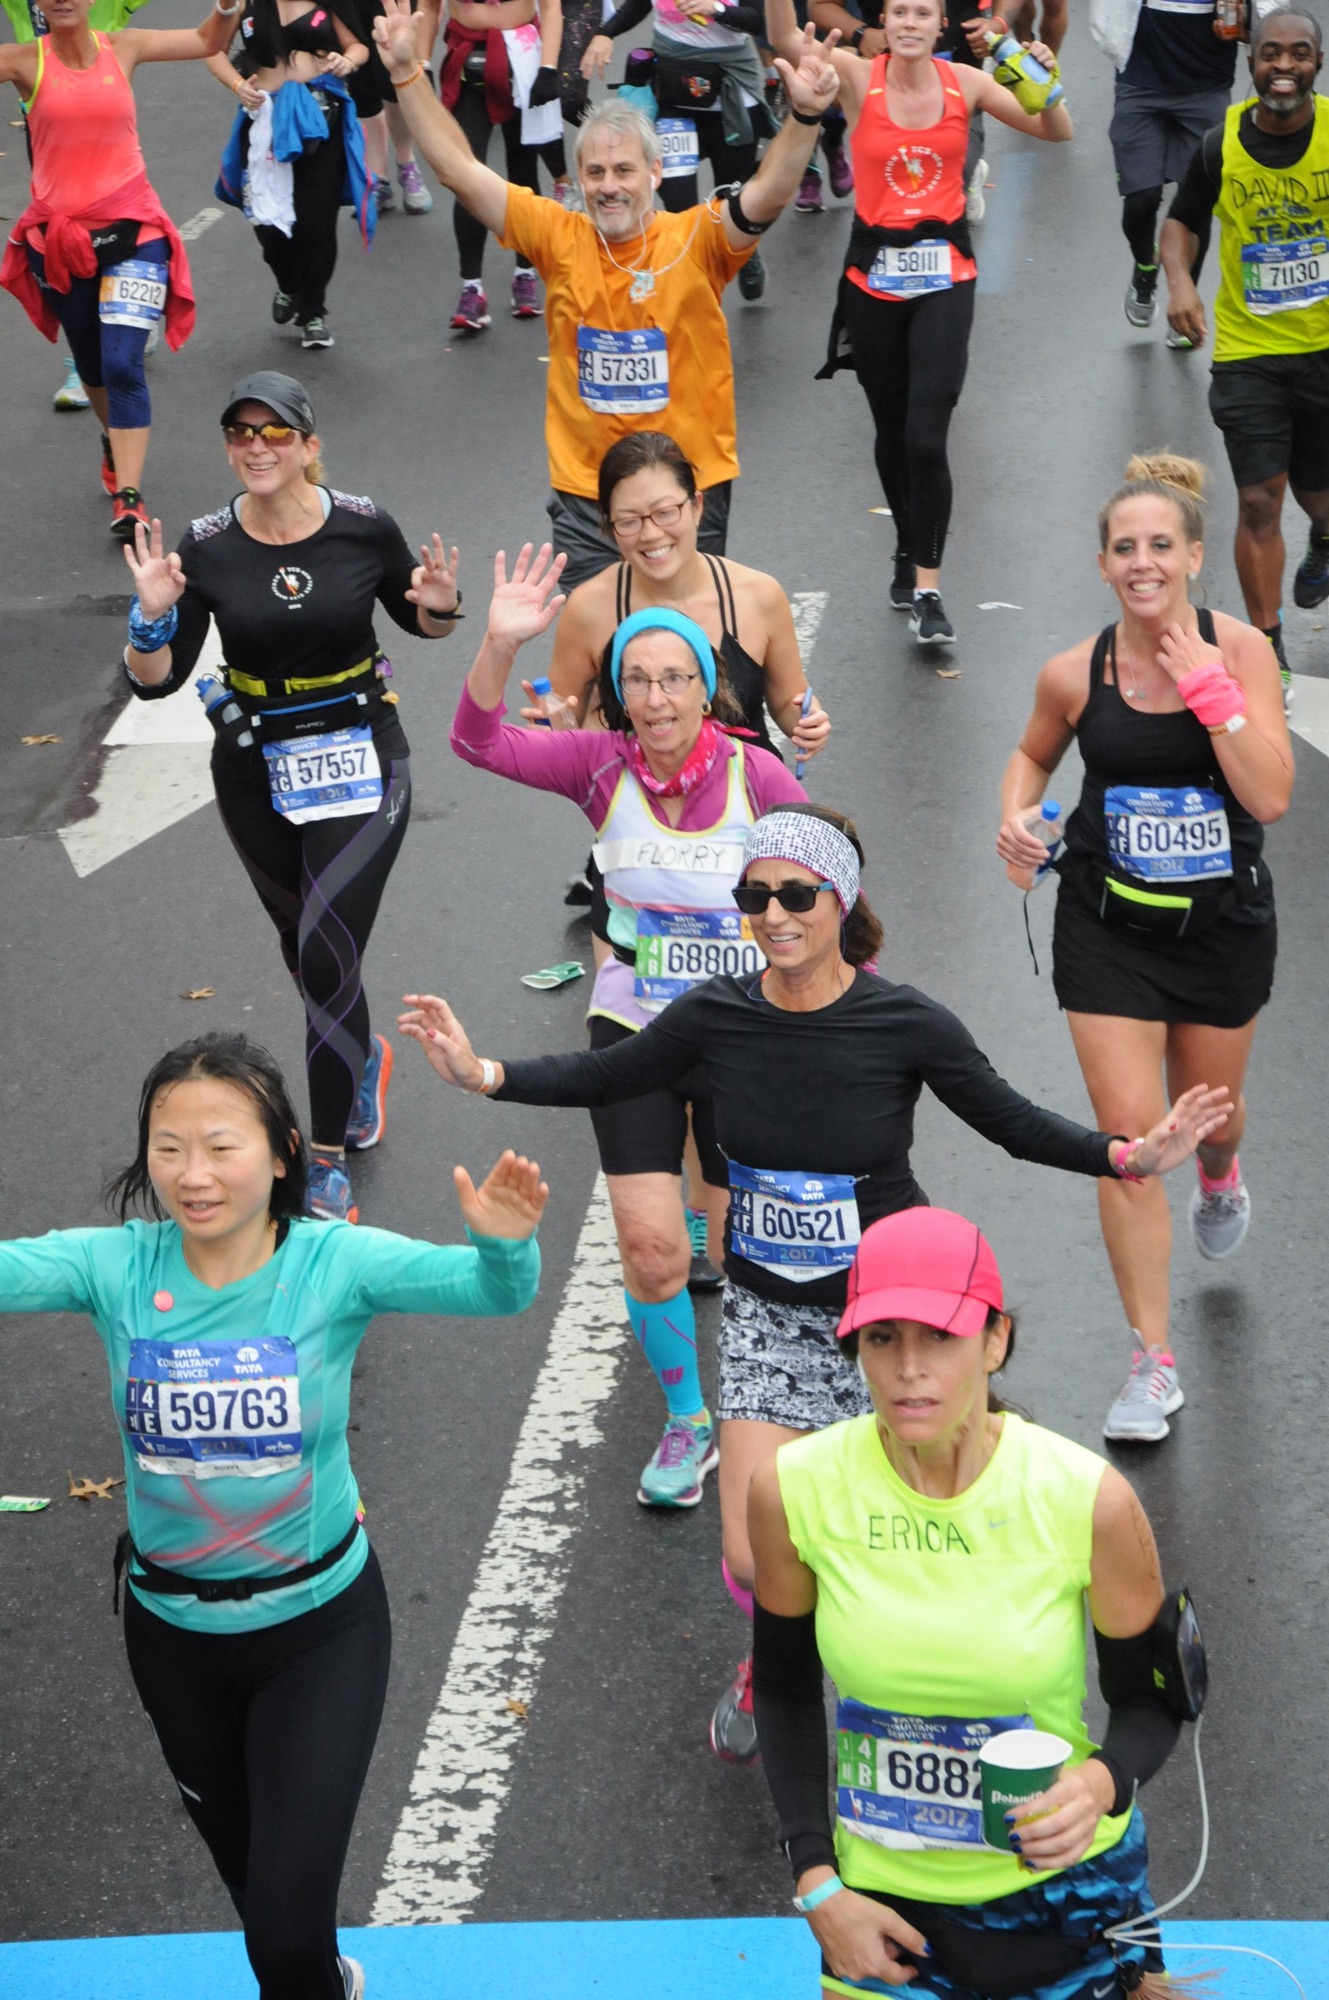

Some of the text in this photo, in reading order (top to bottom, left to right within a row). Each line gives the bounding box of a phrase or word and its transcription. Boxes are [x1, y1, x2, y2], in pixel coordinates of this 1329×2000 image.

[1231, 176, 1308, 209] DAVID
[1249, 219, 1324, 244] TEAM
[897, 251, 938, 273] 58111
[1269, 260, 1320, 287] 71130
[119, 280, 162, 306] 62212
[601, 356, 657, 381] 57331
[297, 747, 367, 785] 57557
[1136, 818, 1223, 852] 60495
[637, 842, 727, 870] FLORRY
[668, 943, 758, 976] 68800
[741, 1193, 751, 1212] 4
[801, 1192, 826, 1201] TATA
[742, 1215, 750, 1234] F
[762, 1202, 847, 1242] 60521
[780, 1247, 816, 1260] 2017
[157, 1357, 221, 1369] CONSULTANCY
[172, 1348, 202, 1358] TATA
[168, 1368, 209, 1379] SERVICES
[233, 1363, 263, 1374] TATA
[142, 1385, 155, 1409] 4
[170, 1386, 289, 1432] 59763
[143, 1412, 158, 1433] E
[869, 1515, 971, 1555] ERICA
[891, 1716, 924, 1724] TATA
[887, 1728, 936, 1741] SERVICES
[962, 1735, 990, 1747] TAT
[857, 1738, 872, 1760] 4
[858, 1761, 872, 1788] B
[913, 1805, 969, 1829] 2017
